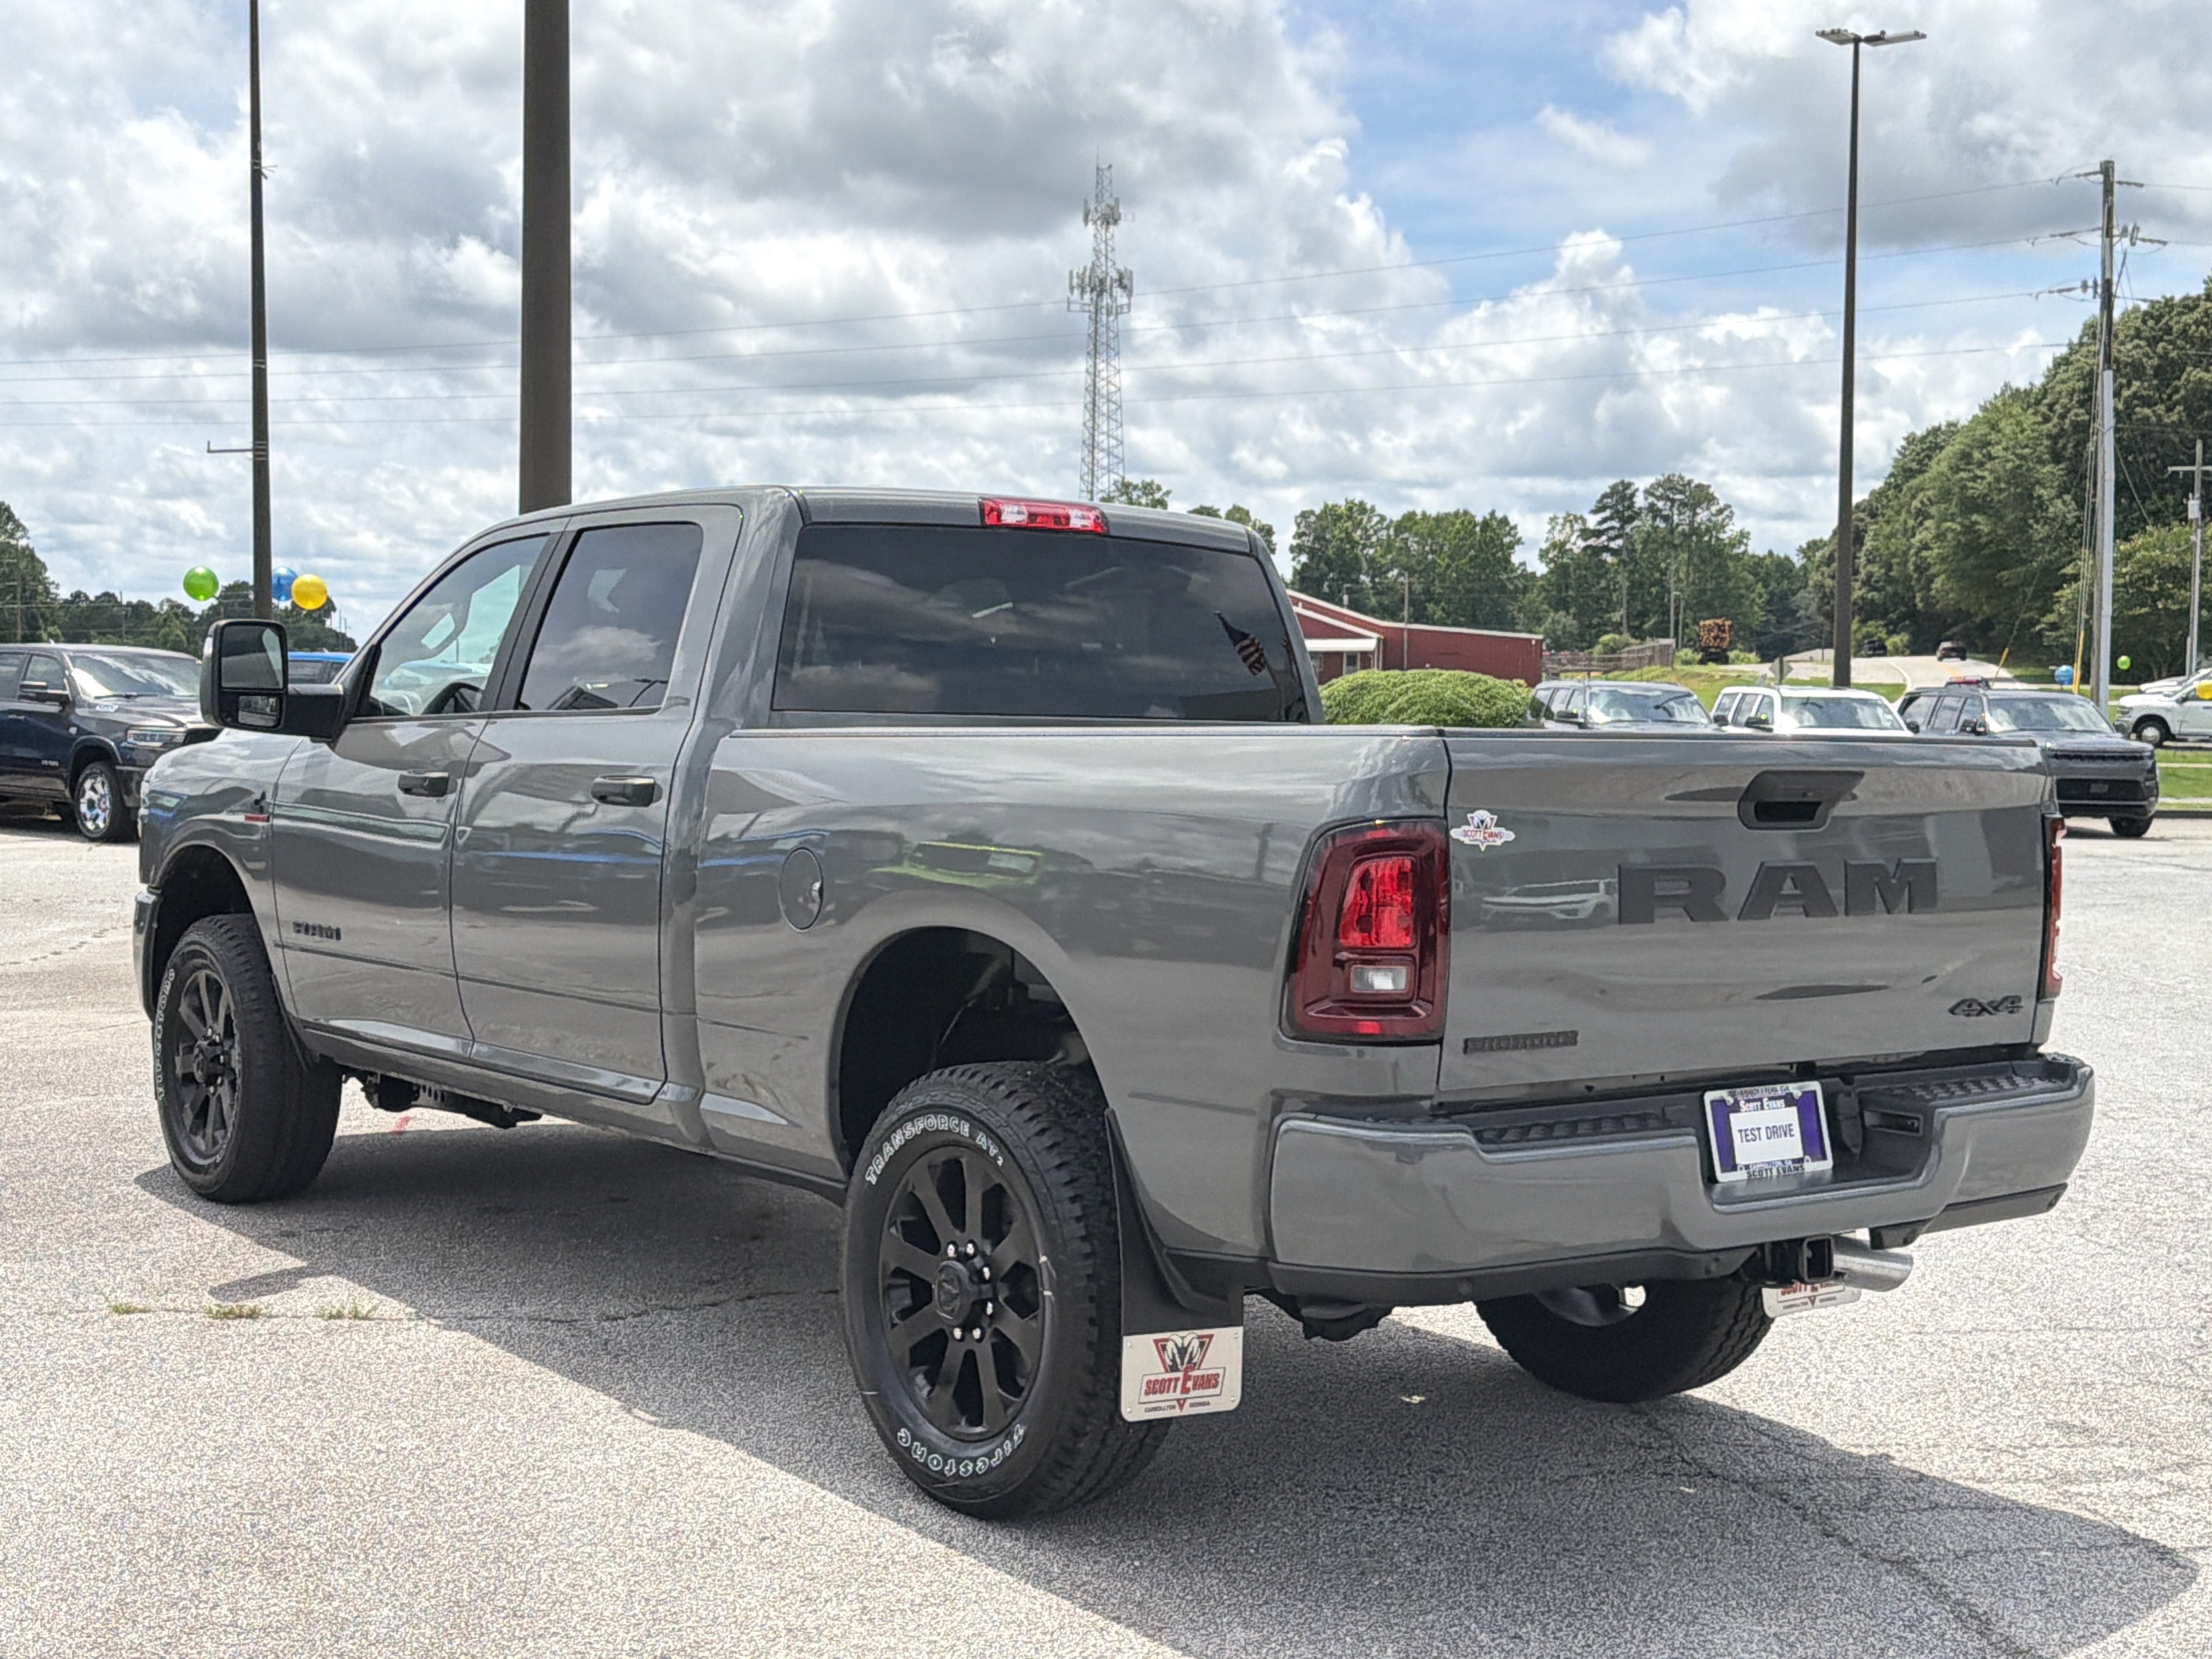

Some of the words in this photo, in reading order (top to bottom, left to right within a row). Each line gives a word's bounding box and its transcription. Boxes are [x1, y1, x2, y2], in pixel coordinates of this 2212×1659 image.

[1617, 858, 1938, 925] RAM
[1737, 1126, 1762, 1143] TEST
[1765, 1123, 1796, 1140] DRIVE
[865, 1114, 970, 1185] TRANSFORCE
[1746, 1166, 1774, 1179] SCOTT
[1144, 1377, 1181, 1396] SCOTT
[1181, 1364, 1220, 1395] EVANS
